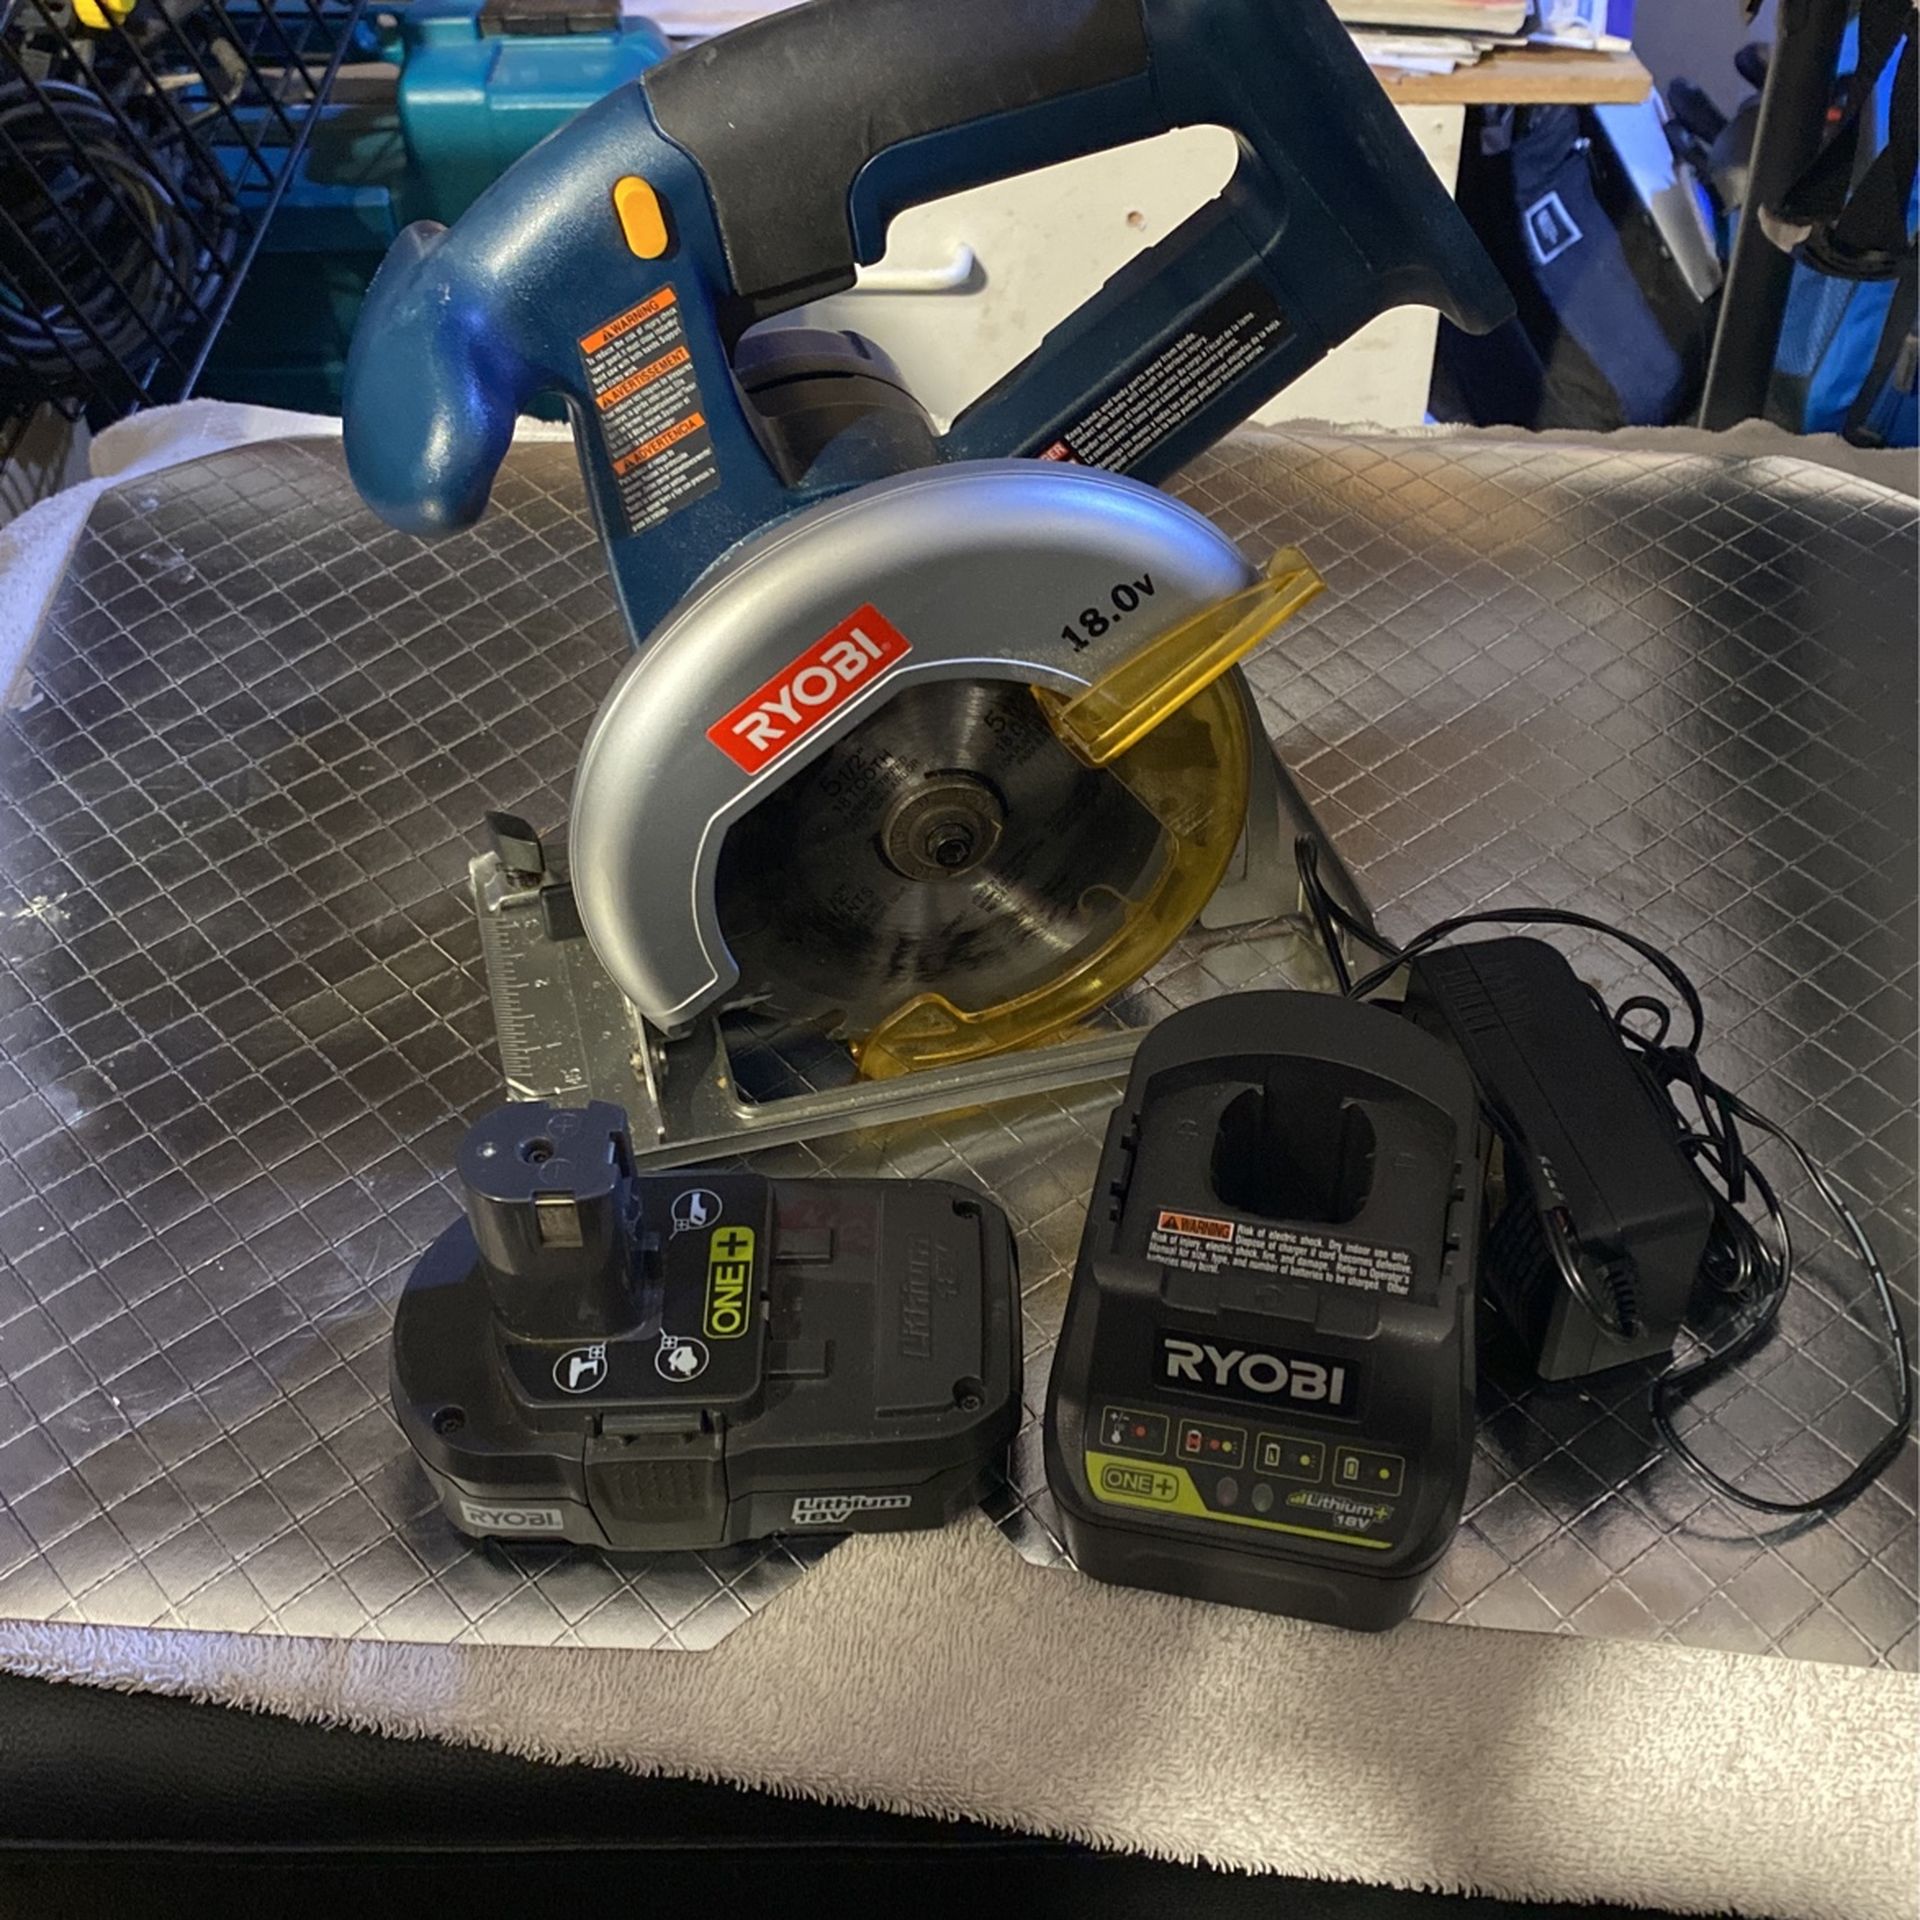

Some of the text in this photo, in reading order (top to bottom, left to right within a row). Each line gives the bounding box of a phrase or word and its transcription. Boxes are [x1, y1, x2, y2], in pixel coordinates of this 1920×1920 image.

[612, 300, 660, 332] WARNING
[612, 348, 687, 401] AVERTISSEMENT
[634, 418, 697, 463] ADVERTENCIA
[1062, 574, 1154, 652] 18.0v
[732, 628, 884, 751] RYOBI
[1181, 1217, 1230, 1237] WARNING
[1256, 1227, 1265, 1238] of
[1268, 1229, 1297, 1243] electric
[710, 1230, 750, 1334] ONE+
[1164, 1338, 1345, 1405] RYOBI
[1105, 1468, 1175, 1498] ONE+
[465, 1505, 554, 1527] RYOBI
[796, 1510, 848, 1523] 18V
[797, 1496, 911, 1512] Lithium
[1335, 1514, 1371, 1529] 18V
